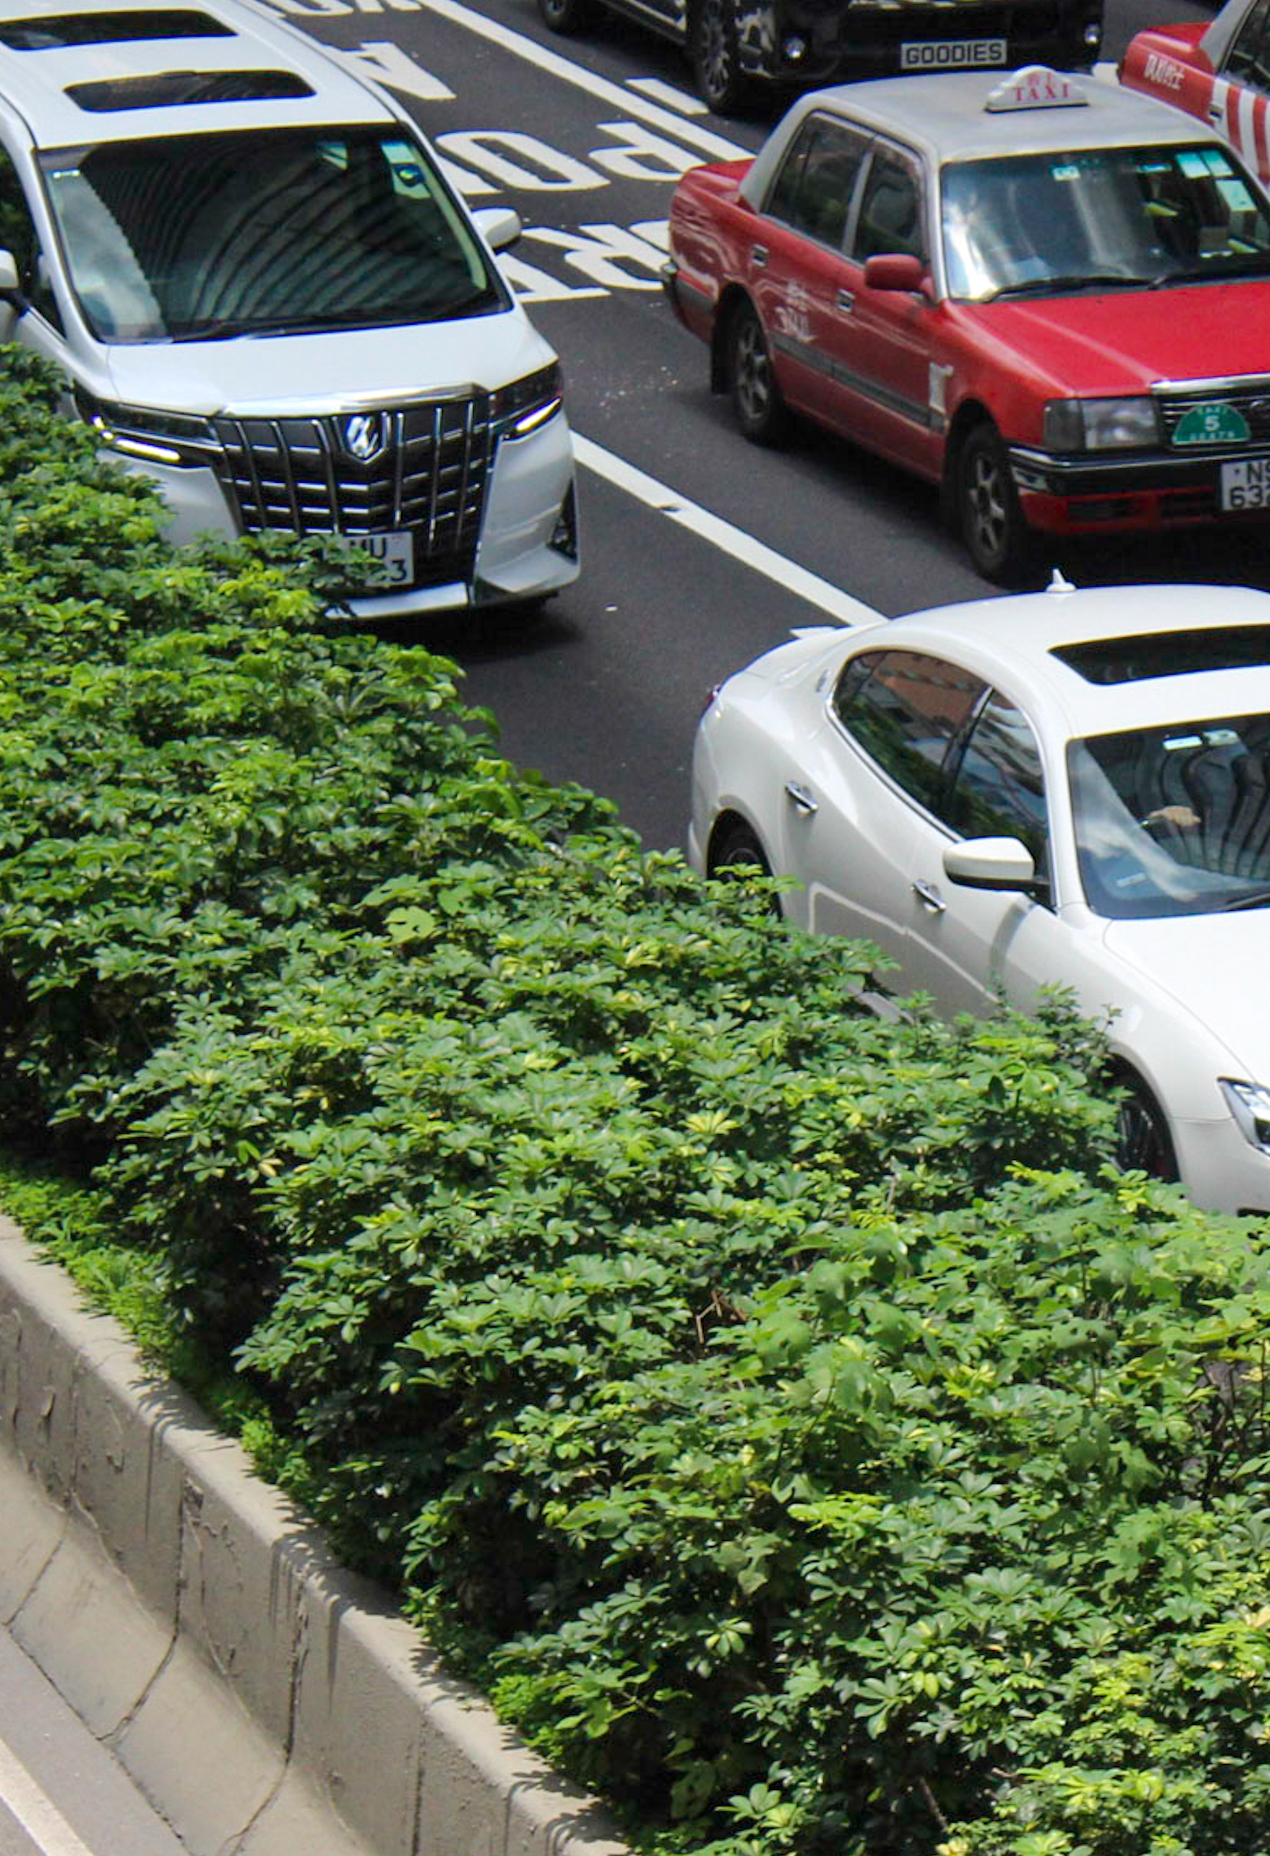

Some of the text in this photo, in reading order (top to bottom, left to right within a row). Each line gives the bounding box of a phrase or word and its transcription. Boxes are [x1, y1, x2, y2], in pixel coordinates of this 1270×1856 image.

[906, 43, 1002, 65] GOODIES
[1014, 83, 1070, 102] TAXI
[1204, 415, 1221, 432] 5
